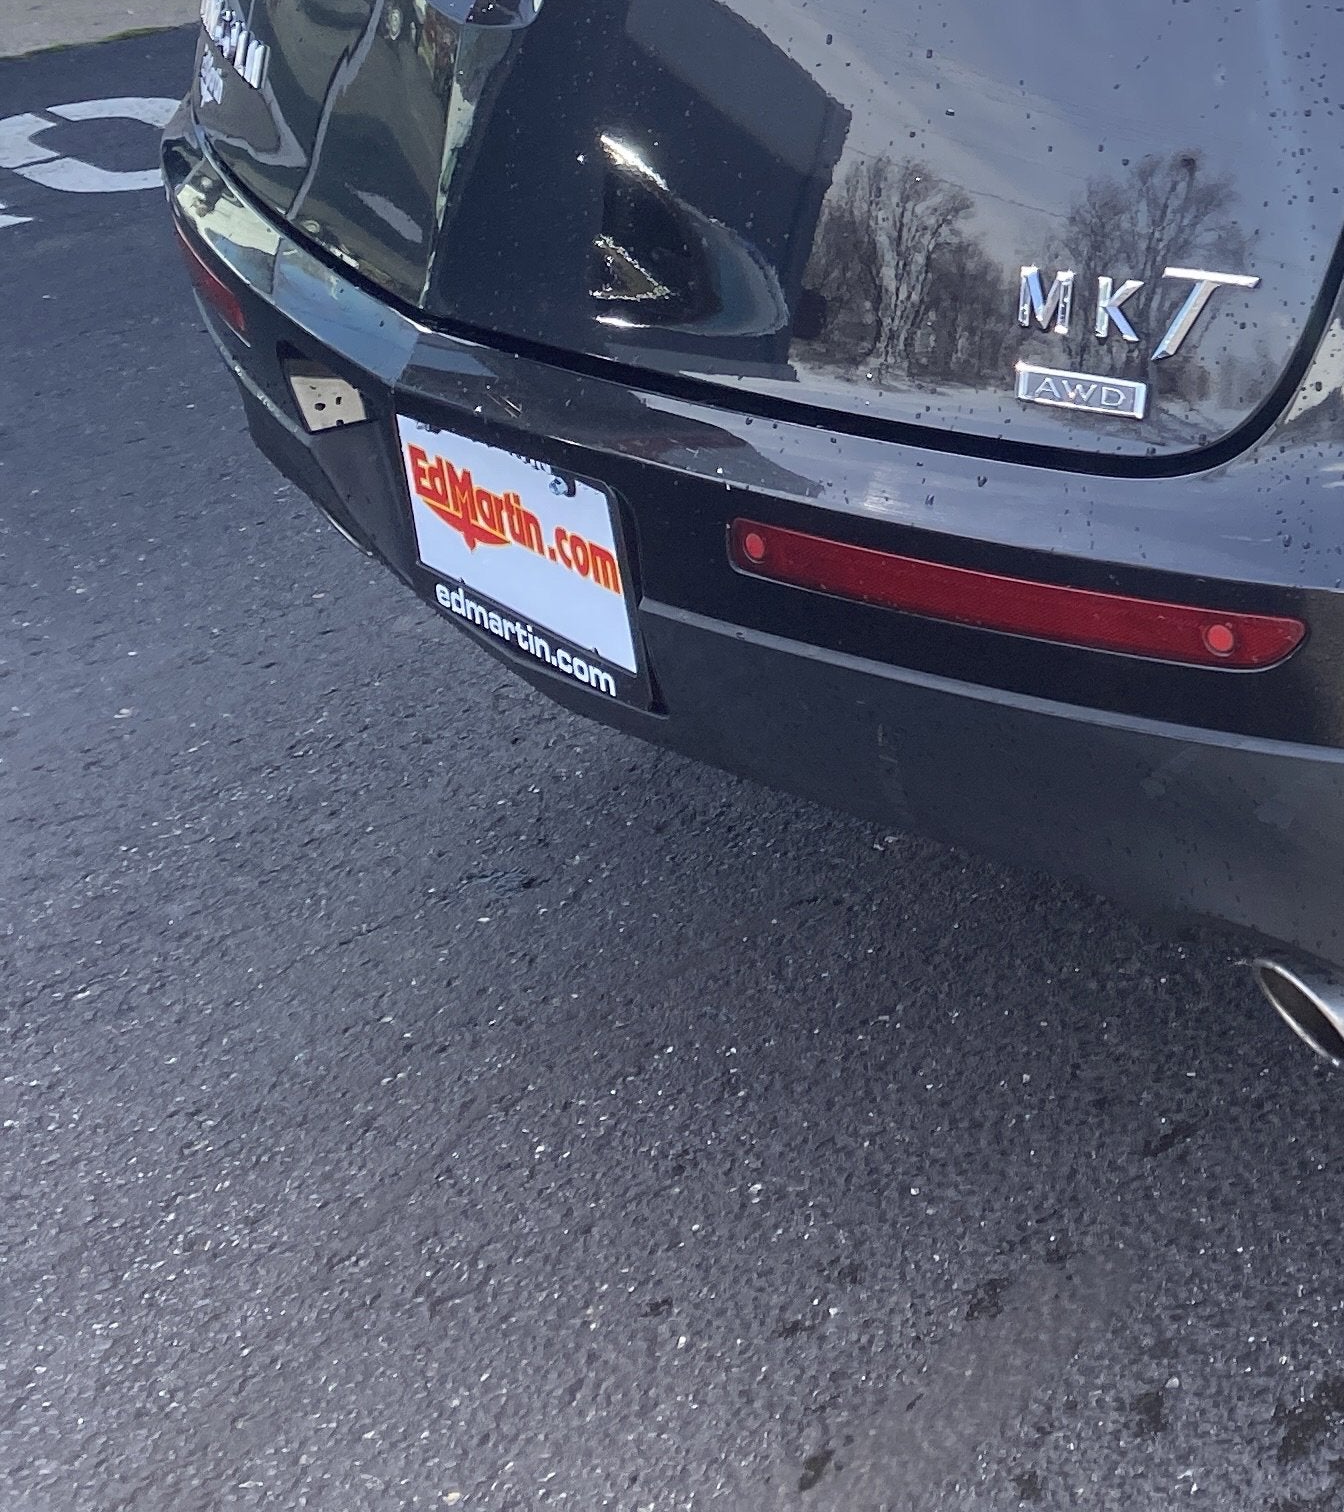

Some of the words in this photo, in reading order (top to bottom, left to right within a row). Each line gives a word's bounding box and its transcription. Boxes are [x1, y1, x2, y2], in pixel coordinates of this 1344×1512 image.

[1017, 264, 1262, 361] MKT
[1034, 377, 1127, 408] AWD
[435, 582, 617, 698] edmartin.com
